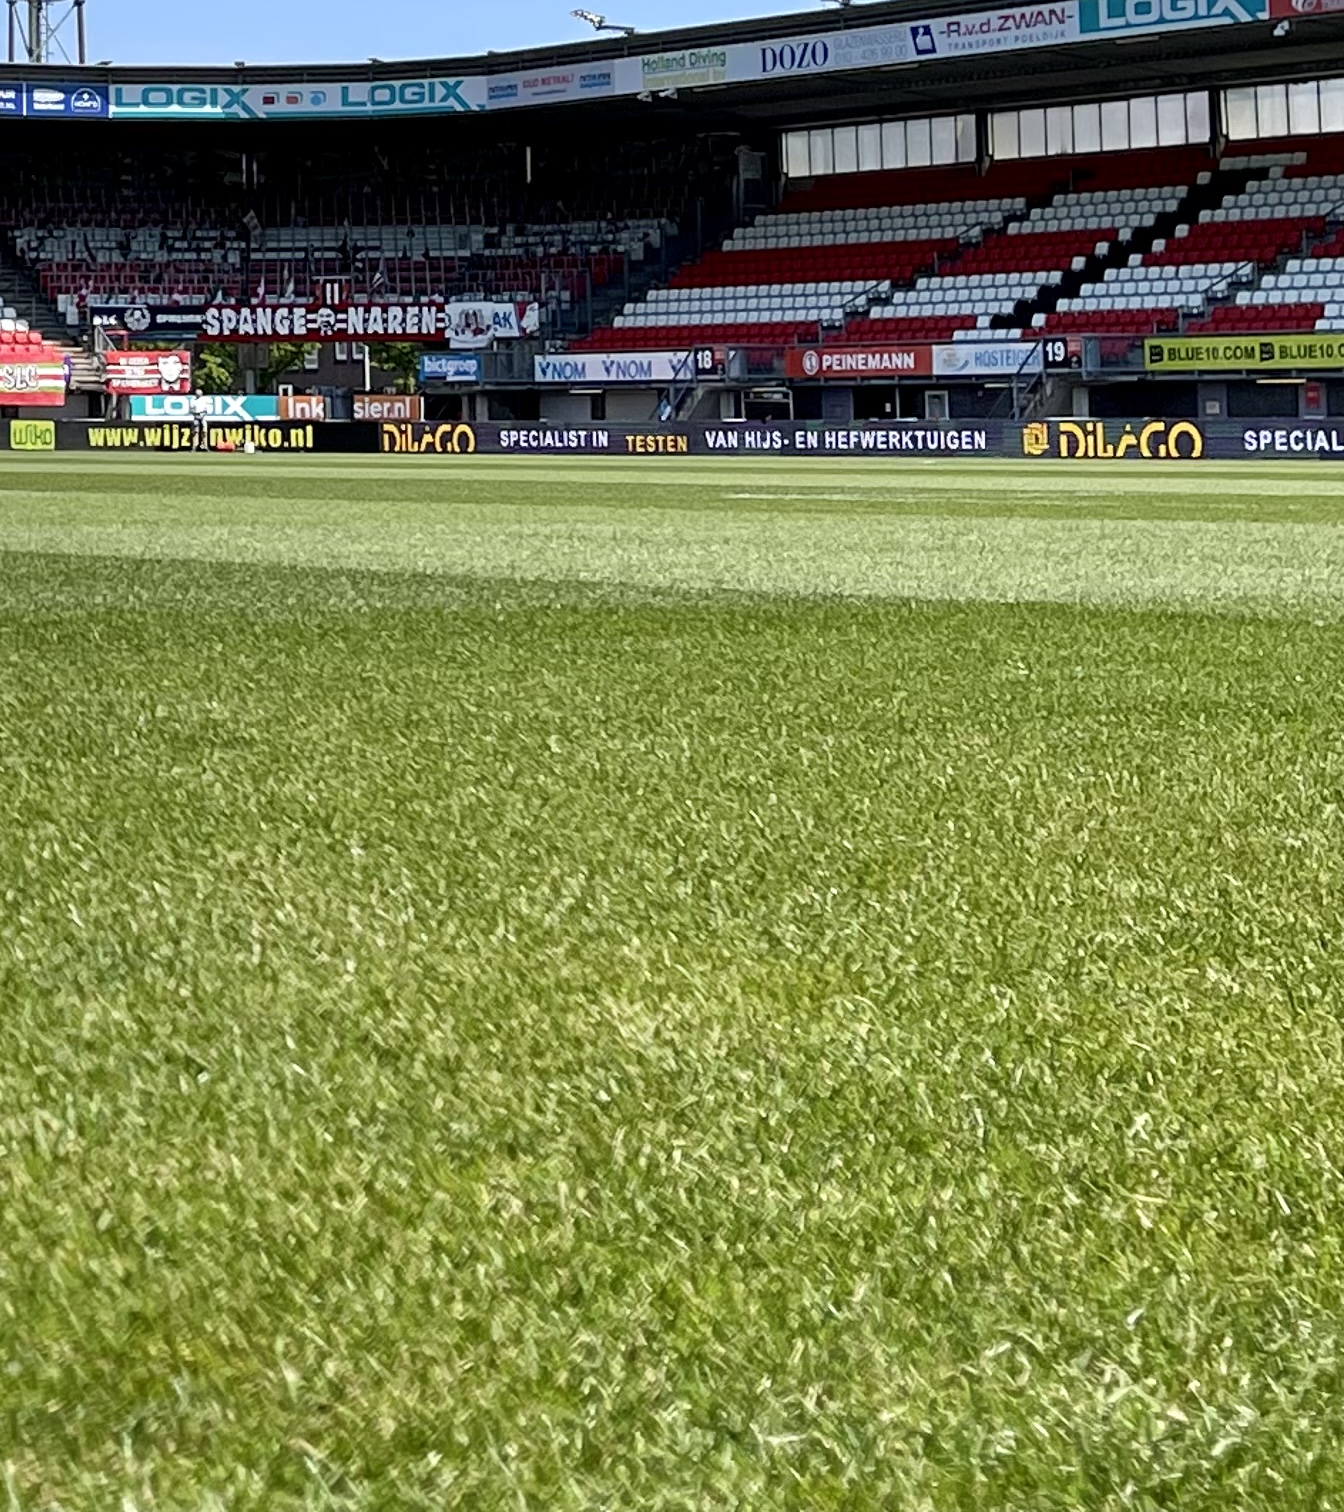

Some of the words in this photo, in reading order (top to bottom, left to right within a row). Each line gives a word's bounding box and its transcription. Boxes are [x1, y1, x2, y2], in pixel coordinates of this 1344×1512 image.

[947, 35, 1008, 52] TRANSPORT
[642, 52, 685, 73] Holland
[689, 49, 727, 69] Diving
[761, 40, 829, 73] DOZO
[115, 85, 265, 118] LOGIX
[341, 80, 468, 111] LOGIX
[203, 307, 306, 336] SPANGE
[347, 306, 437, 335] NAREN
[697, 350, 712, 369] 18
[822, 351, 915, 371] PEINEMANN
[1046, 342, 1065, 362] 19
[1168, 345, 1255, 362] BLUE10.COM
[88, 424, 313, 450] www.wijznwiko.nl
[500, 430, 587, 448] SPECIALIST
[592, 430, 609, 448] IN
[626, 435, 687, 453] TESTEN
[705, 431, 738, 449] VAN
[745, 431, 790, 449] HIJS-
[795, 431, 818, 449] EN
[824, 431, 986, 450] HEFWERKTUIGEN
